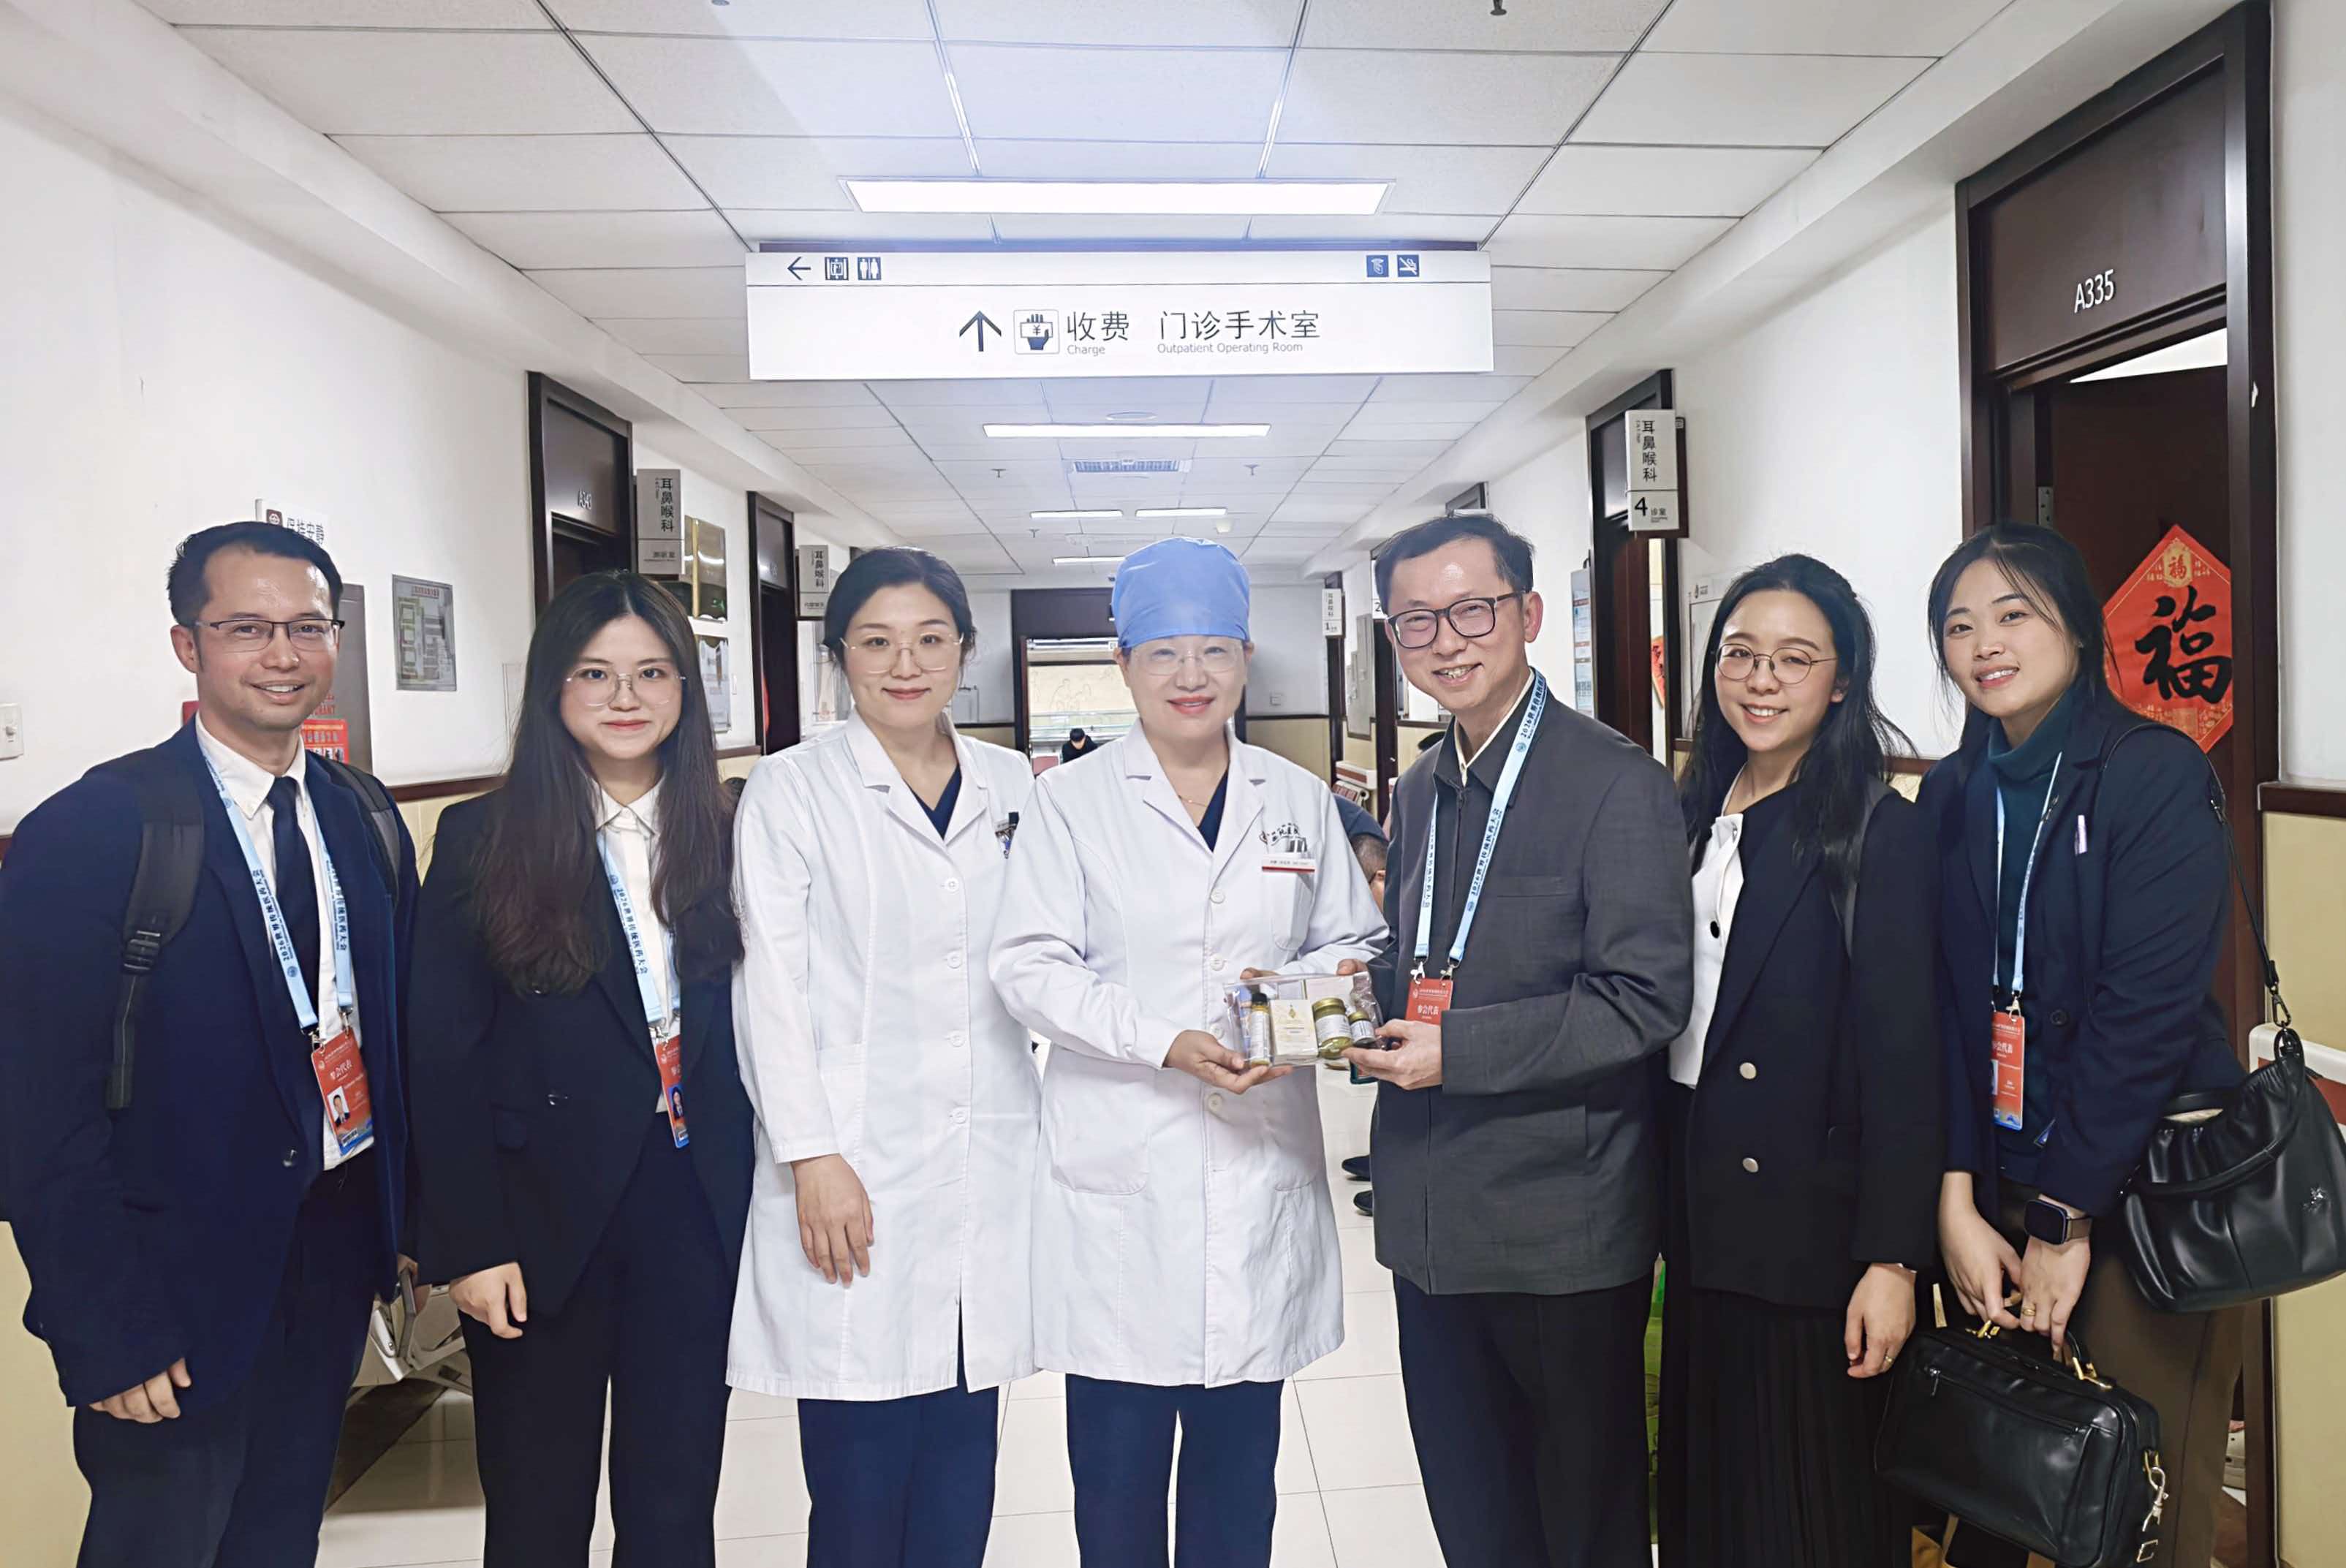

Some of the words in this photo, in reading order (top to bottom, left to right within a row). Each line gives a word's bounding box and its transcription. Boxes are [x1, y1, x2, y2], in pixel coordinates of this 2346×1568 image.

[2074, 268, 2116, 314] A335
[1067, 311, 1130, 341] 收费
[1160, 310, 1320, 341] 门诊手术室
[1067, 344, 1106, 357] Charge
[1157, 342, 1214, 355] Outpatient
[1216, 341, 1269, 355] Operating
[1272, 341, 1303, 352] Room
[1641, 420, 1657, 482] 耳鼻喉科
[660, 477, 675, 533] 耳鼻喉科
[1634, 497, 1648, 517] 4
[2135, 584, 2233, 705] 福
